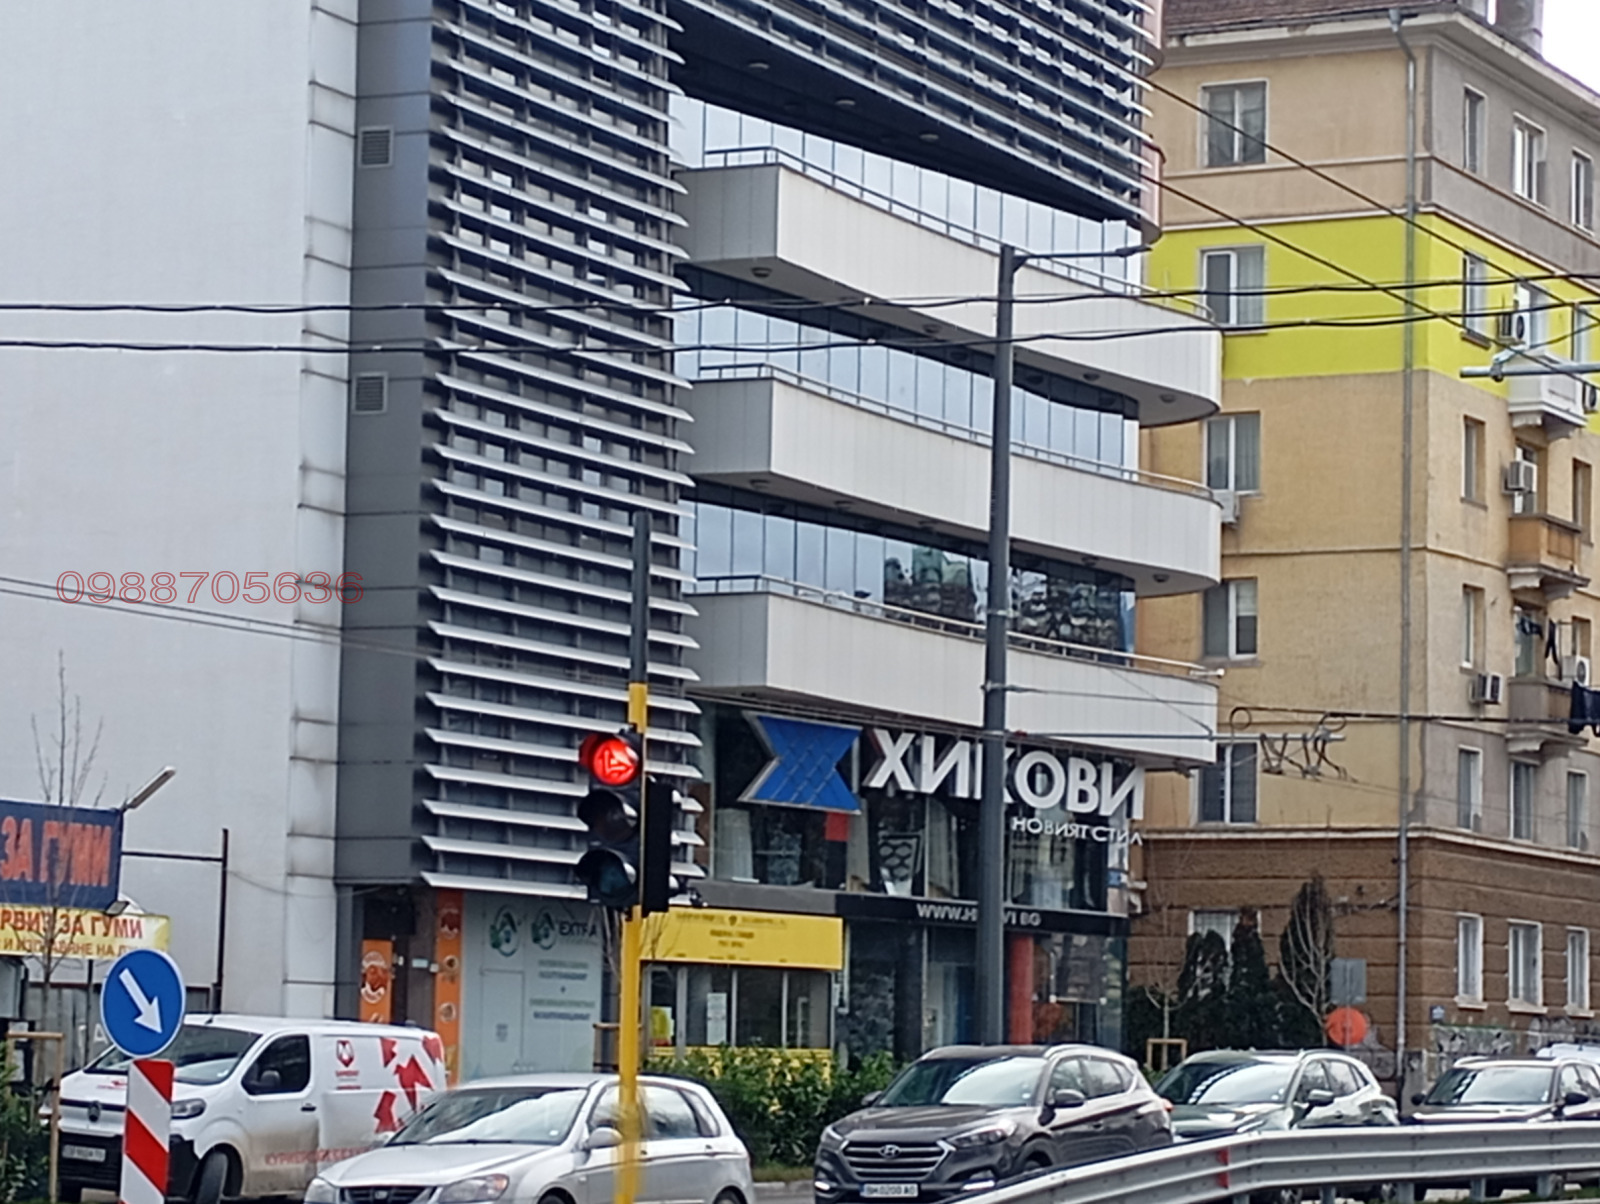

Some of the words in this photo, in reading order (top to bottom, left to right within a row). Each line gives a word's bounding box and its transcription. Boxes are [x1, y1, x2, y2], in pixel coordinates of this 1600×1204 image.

[1011, 816, 1090, 840] НОВИЯТ
[1091, 826, 1143, 846] СТИЛ
[0, 815, 33, 883] ЗА
[40, 820, 111, 887] ГУМИ
[59, 914, 84, 935] ЗА
[91, 916, 143, 939] ГУМИ
[97, 945, 115, 958] НА
